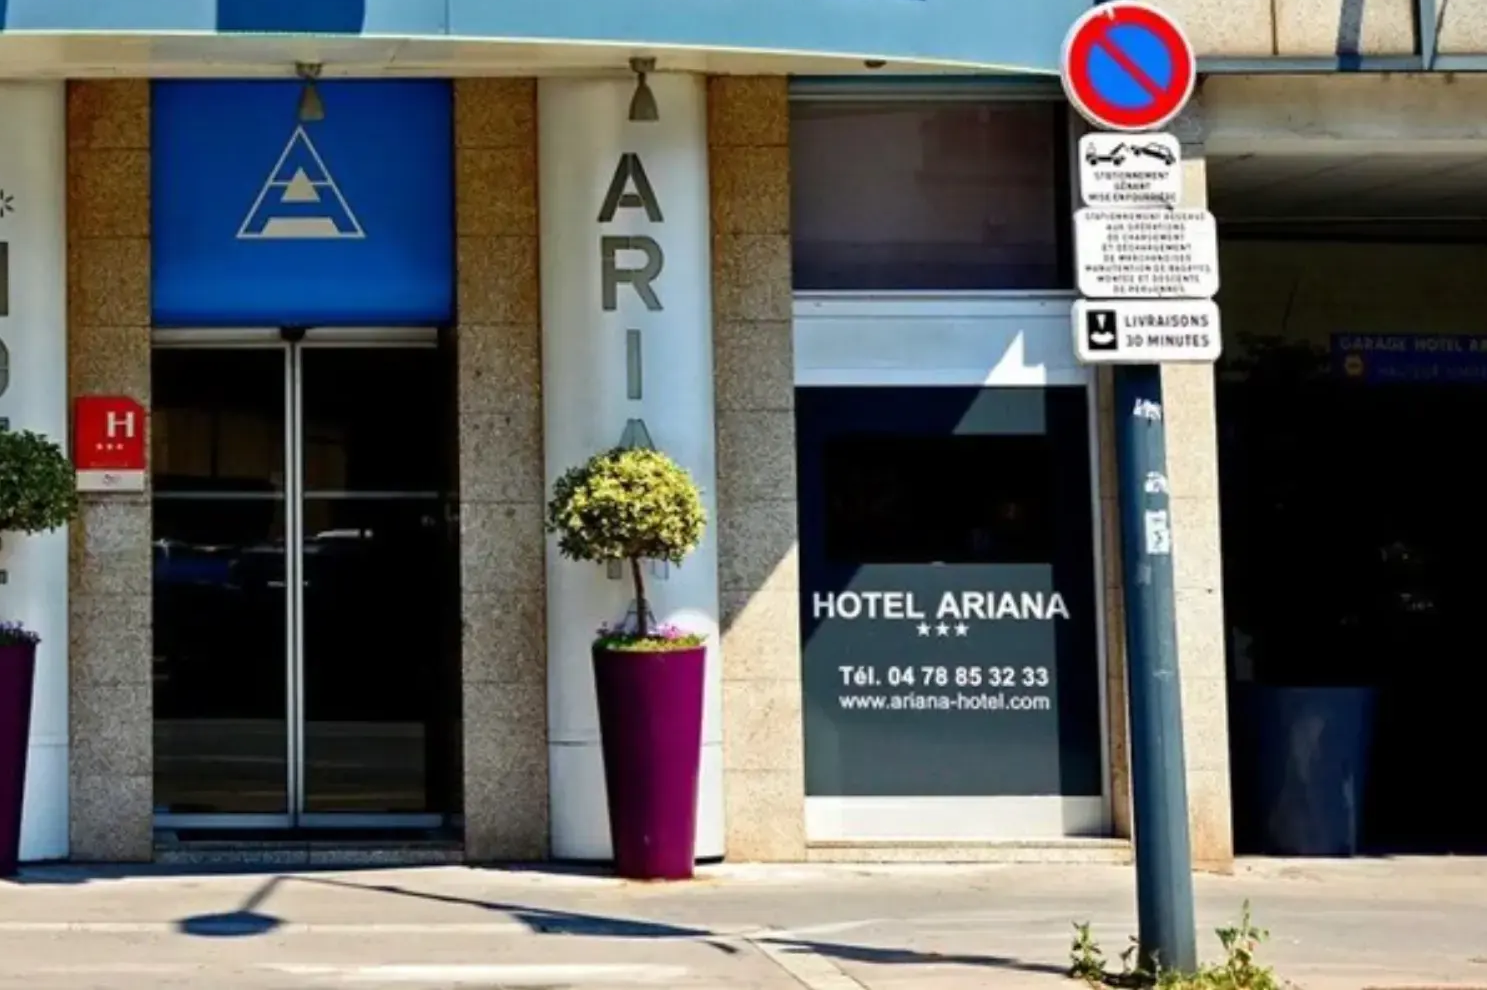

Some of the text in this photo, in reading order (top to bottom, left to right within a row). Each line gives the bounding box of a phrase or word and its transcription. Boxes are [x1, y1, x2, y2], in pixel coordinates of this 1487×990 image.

[1124, 313, 1209, 328] LIVRAISONS
[1146, 334, 1210, 348] MINUTES
[107, 410, 135, 438] H
[811, 590, 1070, 620] HOTEL ARIANA
[838, 665, 1050, 687] Tél. 04 78 85 32 33
[838, 692, 1051, 711] www.ariana-hotel.com
